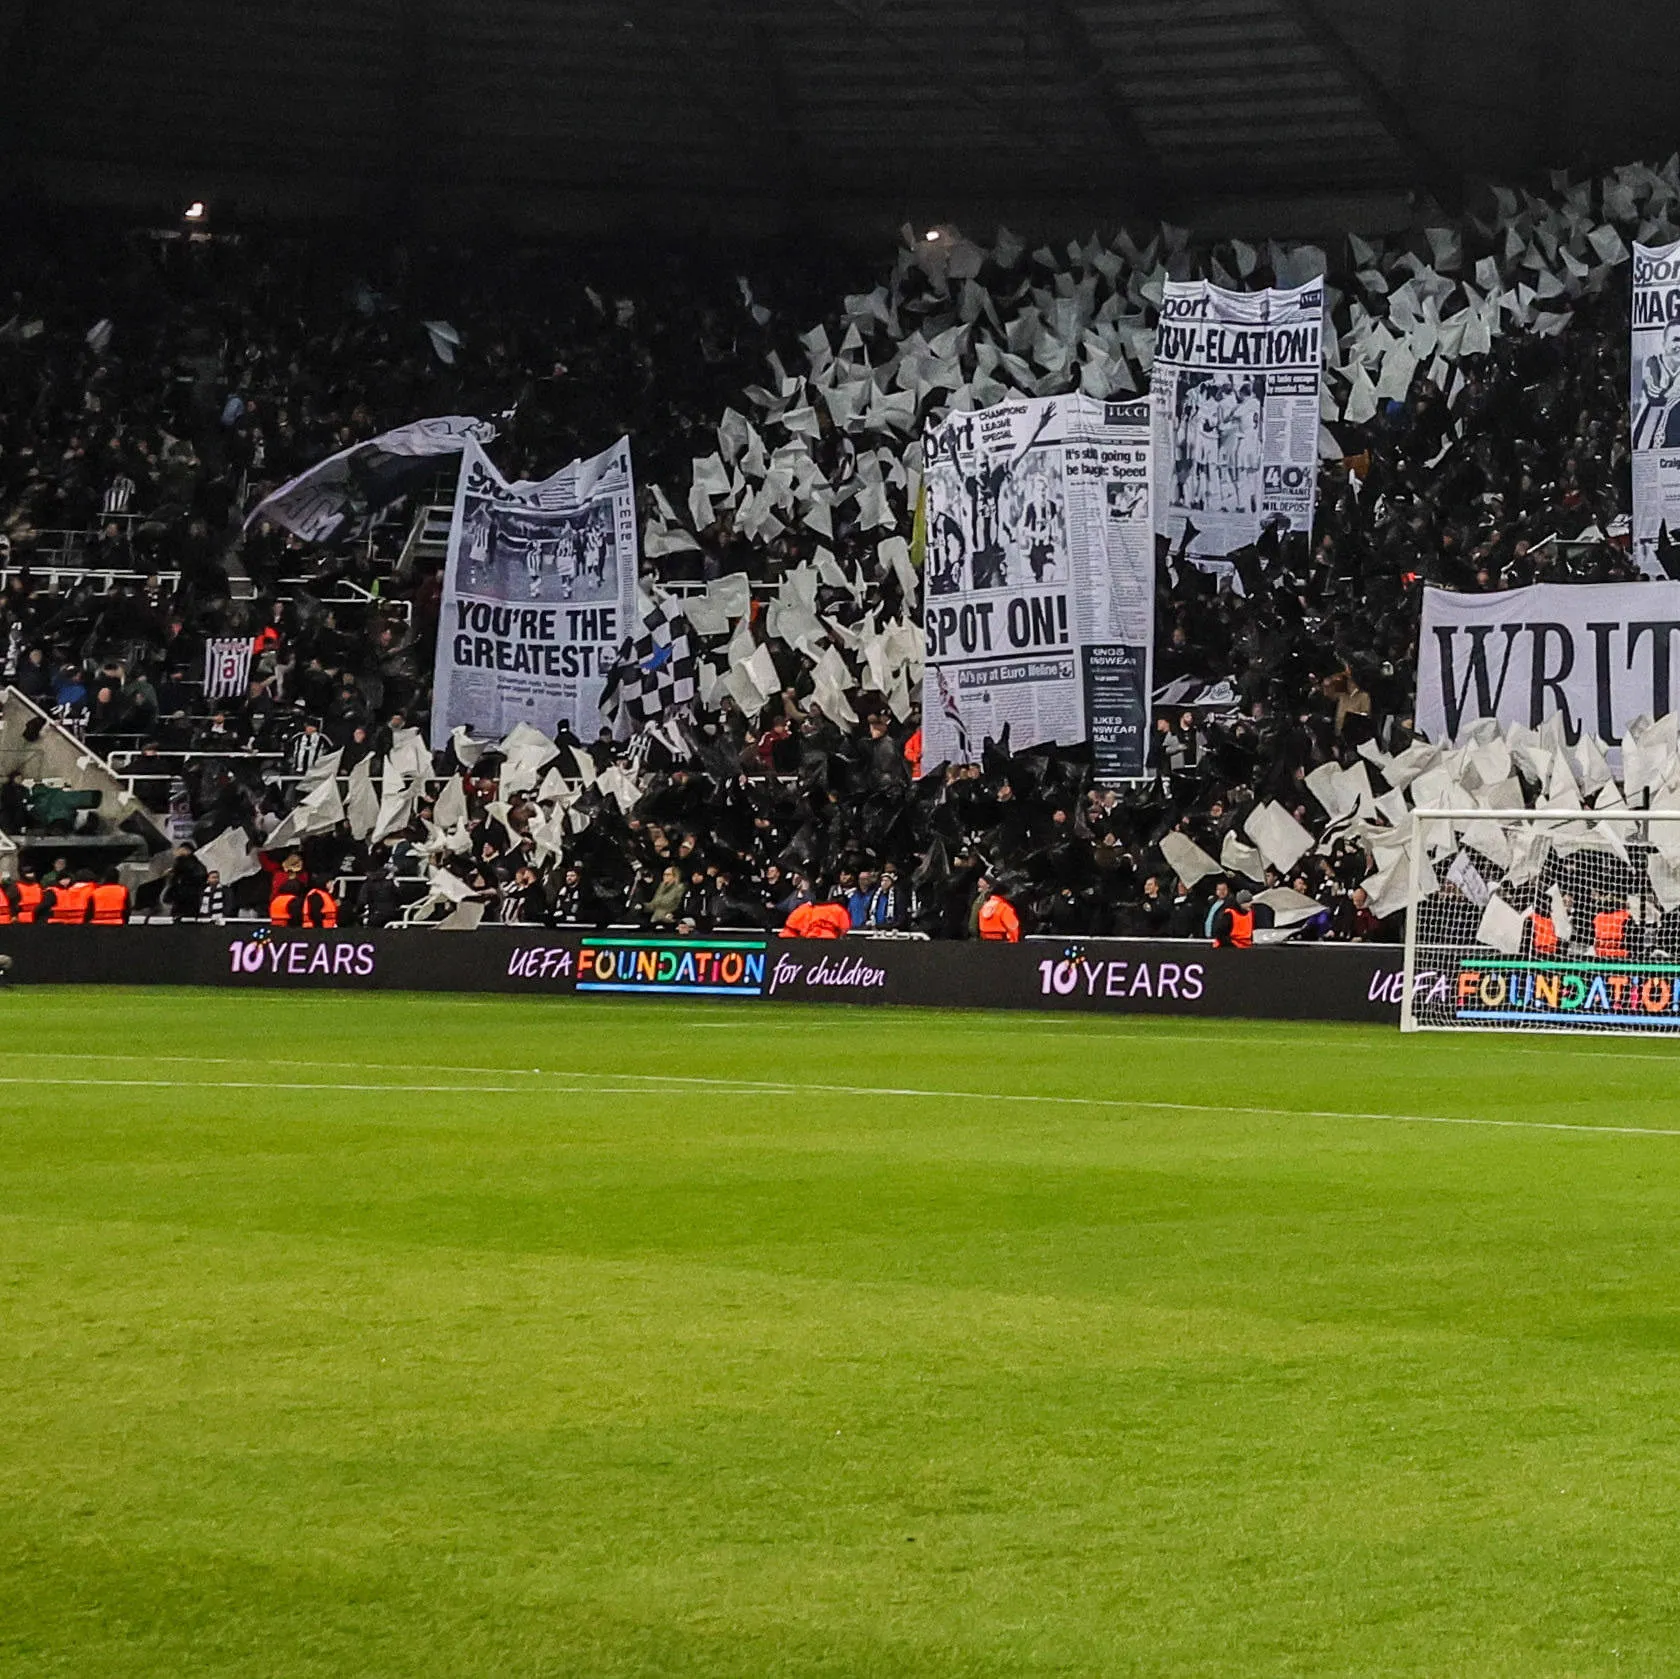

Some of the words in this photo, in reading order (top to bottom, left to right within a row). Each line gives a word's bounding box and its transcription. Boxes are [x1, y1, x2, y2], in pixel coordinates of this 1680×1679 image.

[1065, 448, 1080, 460] It's
[1101, 449, 1131, 464] going
[1135, 449, 1146, 461] to
[1066, 464, 1079, 475] be
[1112, 464, 1147, 479] Speed
[456, 599, 557, 641] YOU'RE
[565, 608, 617, 641] THE
[925, 602, 994, 657] SPOT
[1007, 594, 1069, 649] ON!
[453, 634, 594, 678] GREATEST
[1000, 665, 1026, 679] Euro
[507, 947, 573, 978] UEFA
[768, 952, 803, 995] for
[805, 952, 885, 987] children
[1367, 969, 1450, 1005] UEFA
